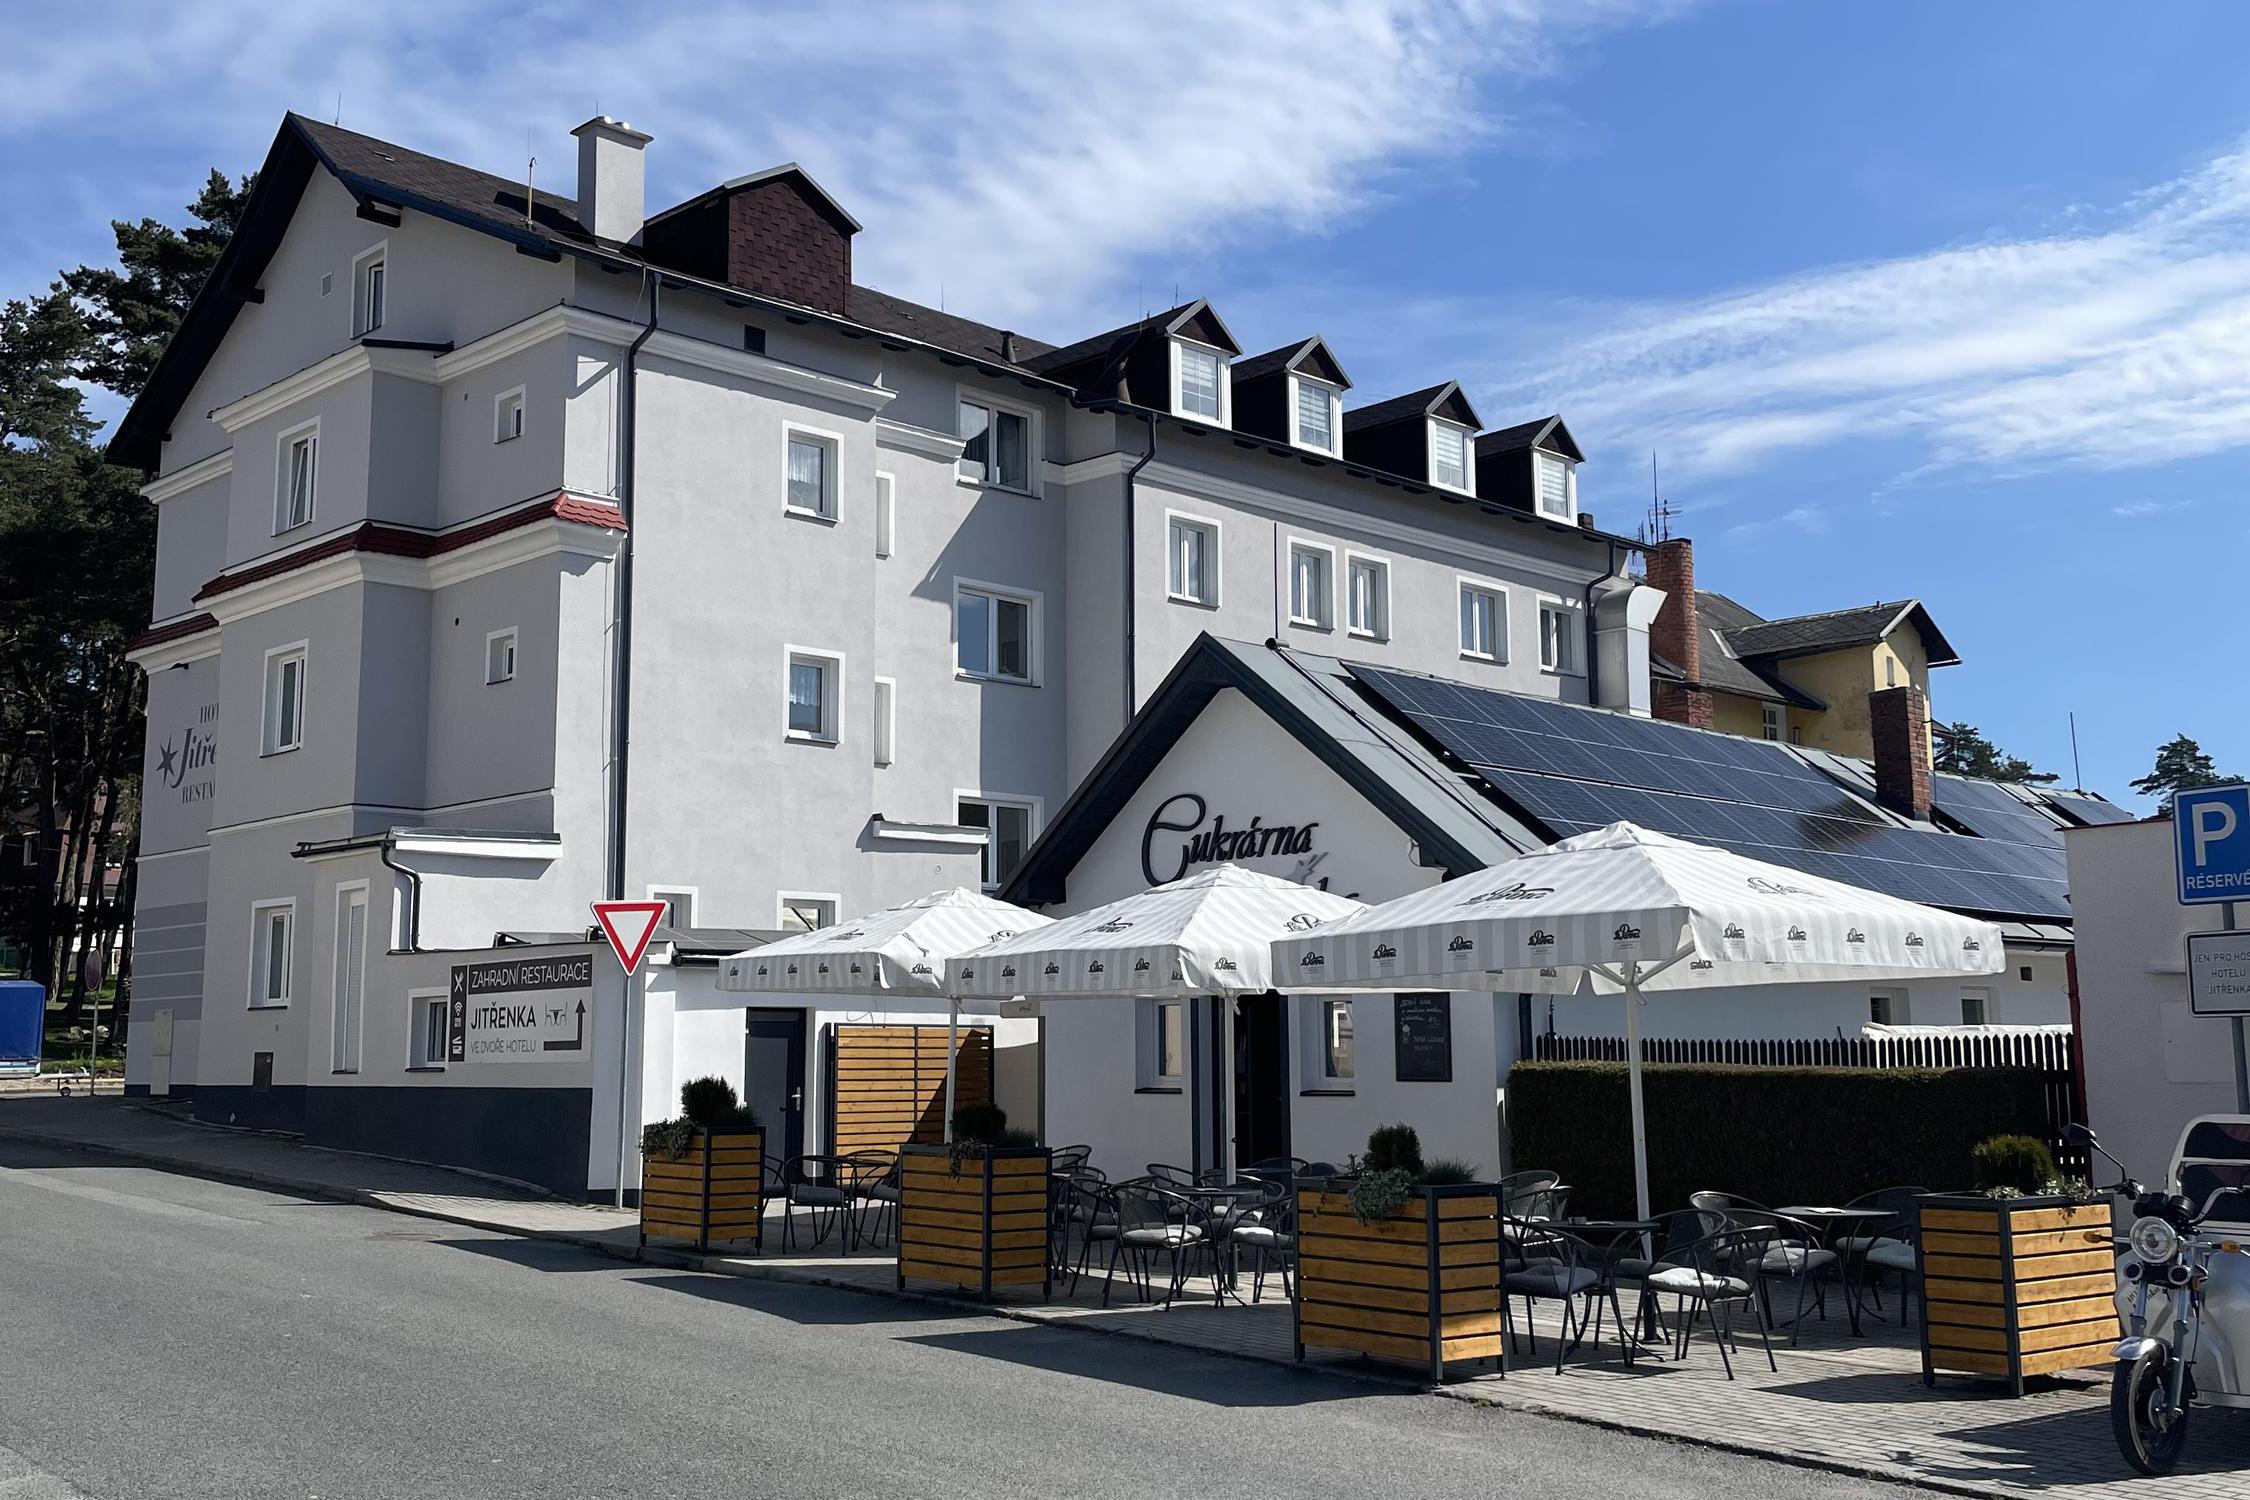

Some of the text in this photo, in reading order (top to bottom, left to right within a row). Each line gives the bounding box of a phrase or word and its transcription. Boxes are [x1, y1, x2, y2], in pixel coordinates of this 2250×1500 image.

[200, 703, 219, 723] HOT
[1141, 794, 1319, 887] Cukrárna
[2192, 801, 2237, 867] P
[2193, 952, 2250, 963] JEN PRO HOS
[471, 962, 589, 989] ZAHRADNÍ RESTAURACE
[2211, 968, 2246, 978] HOTELU
[471, 1001, 537, 1030] JITŘENKA
[470, 1038, 537, 1053] VE DVOŘE HOTELU
